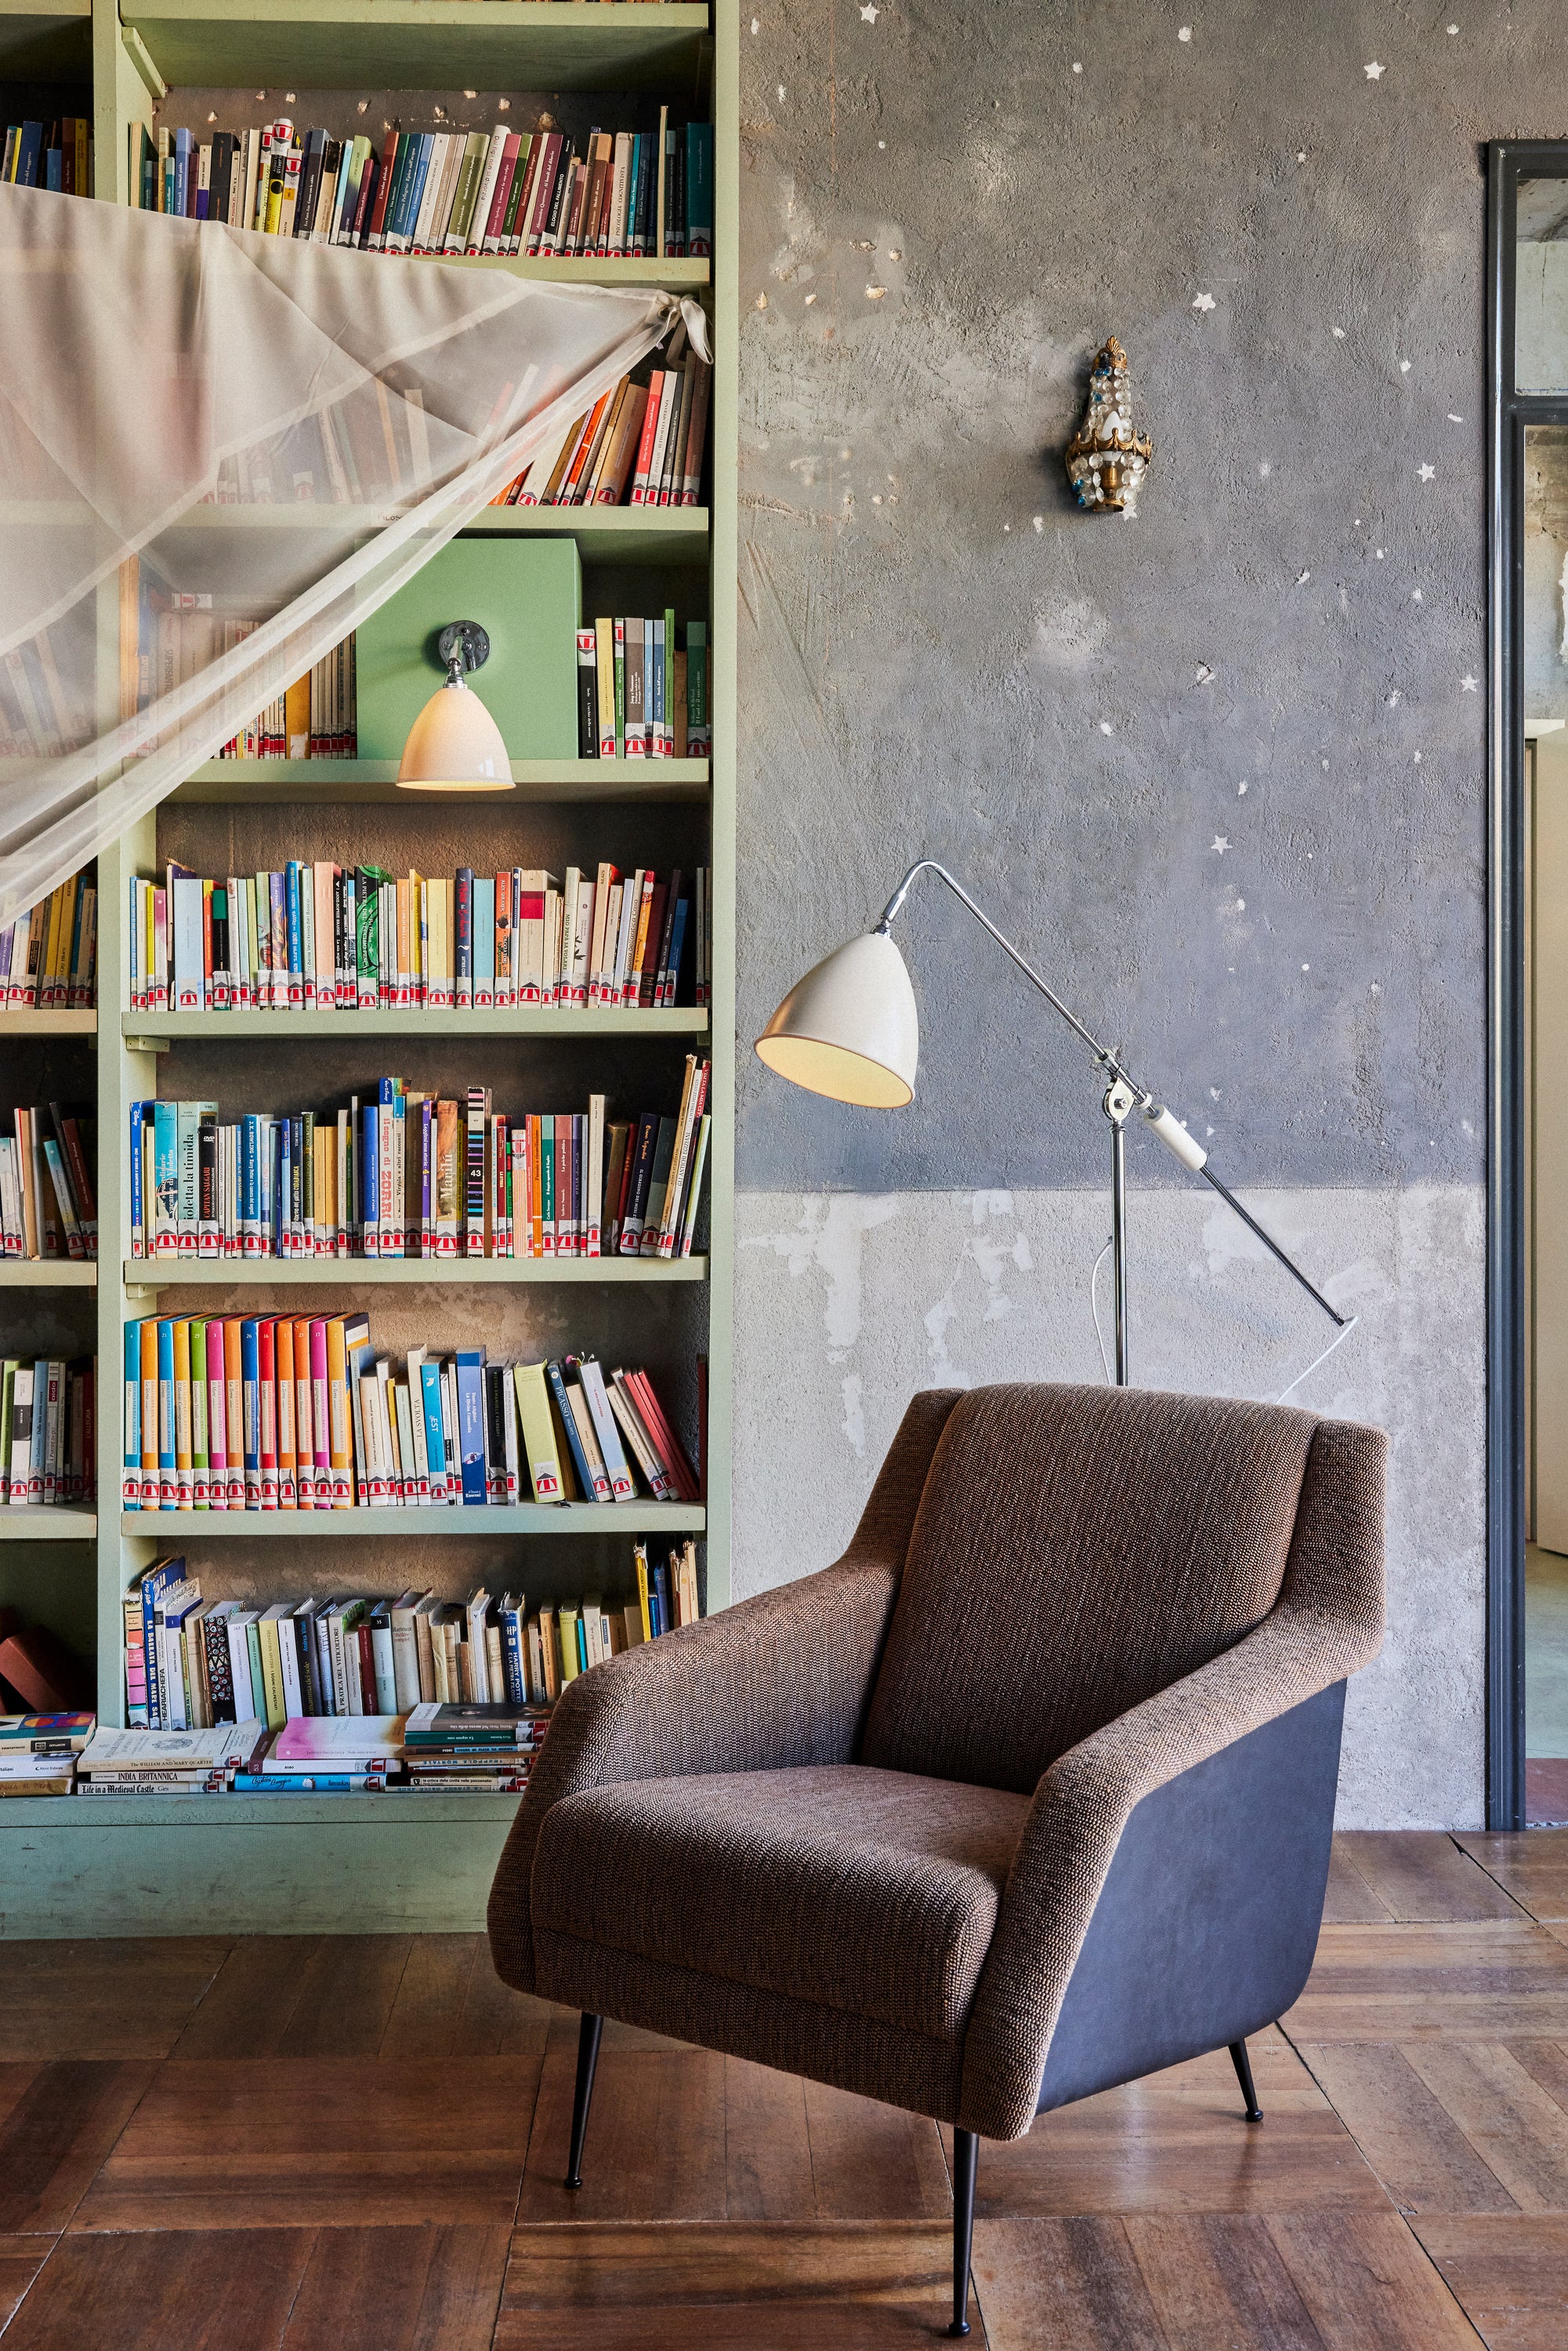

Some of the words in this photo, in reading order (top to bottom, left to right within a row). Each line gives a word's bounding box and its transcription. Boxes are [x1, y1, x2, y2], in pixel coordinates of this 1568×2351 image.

[480, 177, 490, 200] divorzia
[555, 174, 564, 201] FALLIMENTO
[183, 1134, 194, 1170] timida
[682, 1132, 691, 1154] EGIZIANI
[384, 1157, 390, 1165] di
[679, 1155, 687, 1178] ANTICHI
[183, 1172, 194, 1183] la
[556, 1386, 570, 1417] PICASSO
[417, 1428, 422, 1437] LA
[147, 1620, 154, 1629] LA
[333, 1626, 342, 1665] VITICOLTORE
[82, 1785, 94, 1794] Life
[136, 1784, 154, 1793] Castle
